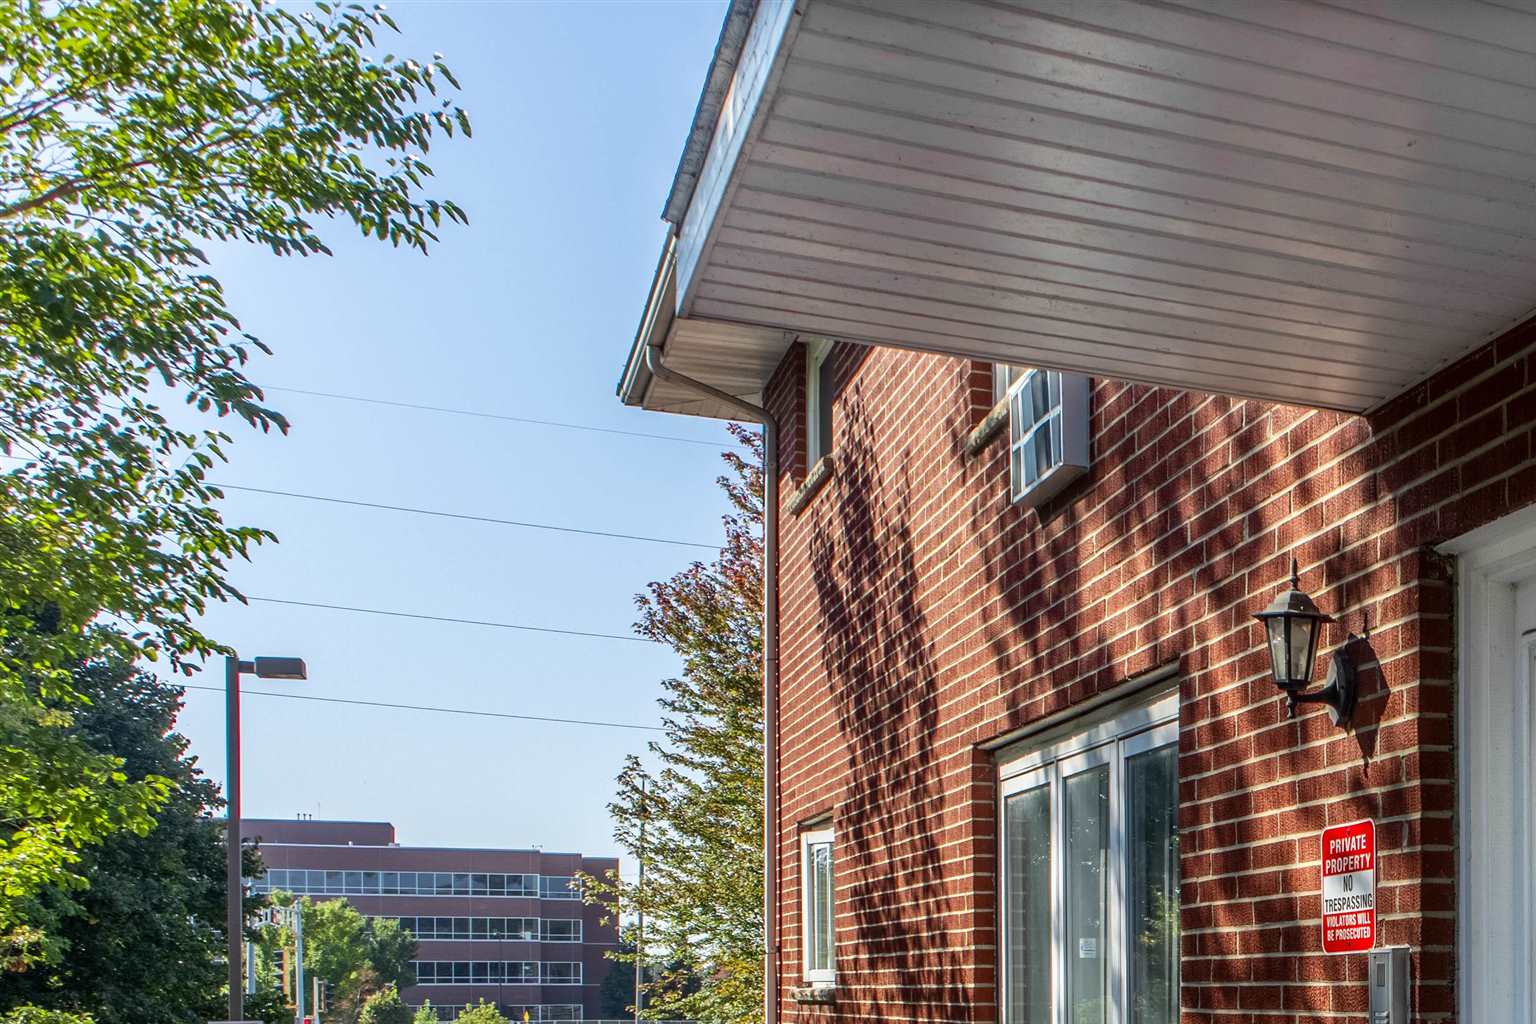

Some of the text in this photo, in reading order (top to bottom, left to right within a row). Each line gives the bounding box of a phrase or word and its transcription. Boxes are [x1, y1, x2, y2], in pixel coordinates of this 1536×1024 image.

[1329, 833, 1367, 855] PRIVATE
[1325, 852, 1372, 875] PROPERTY
[1343, 874, 1354, 893] NO
[1324, 893, 1373, 913] TRESPASSING
[1326, 912, 1371, 928] VIOLATORS WILL
[1327, 926, 1371, 942] BE PROSECUTED
